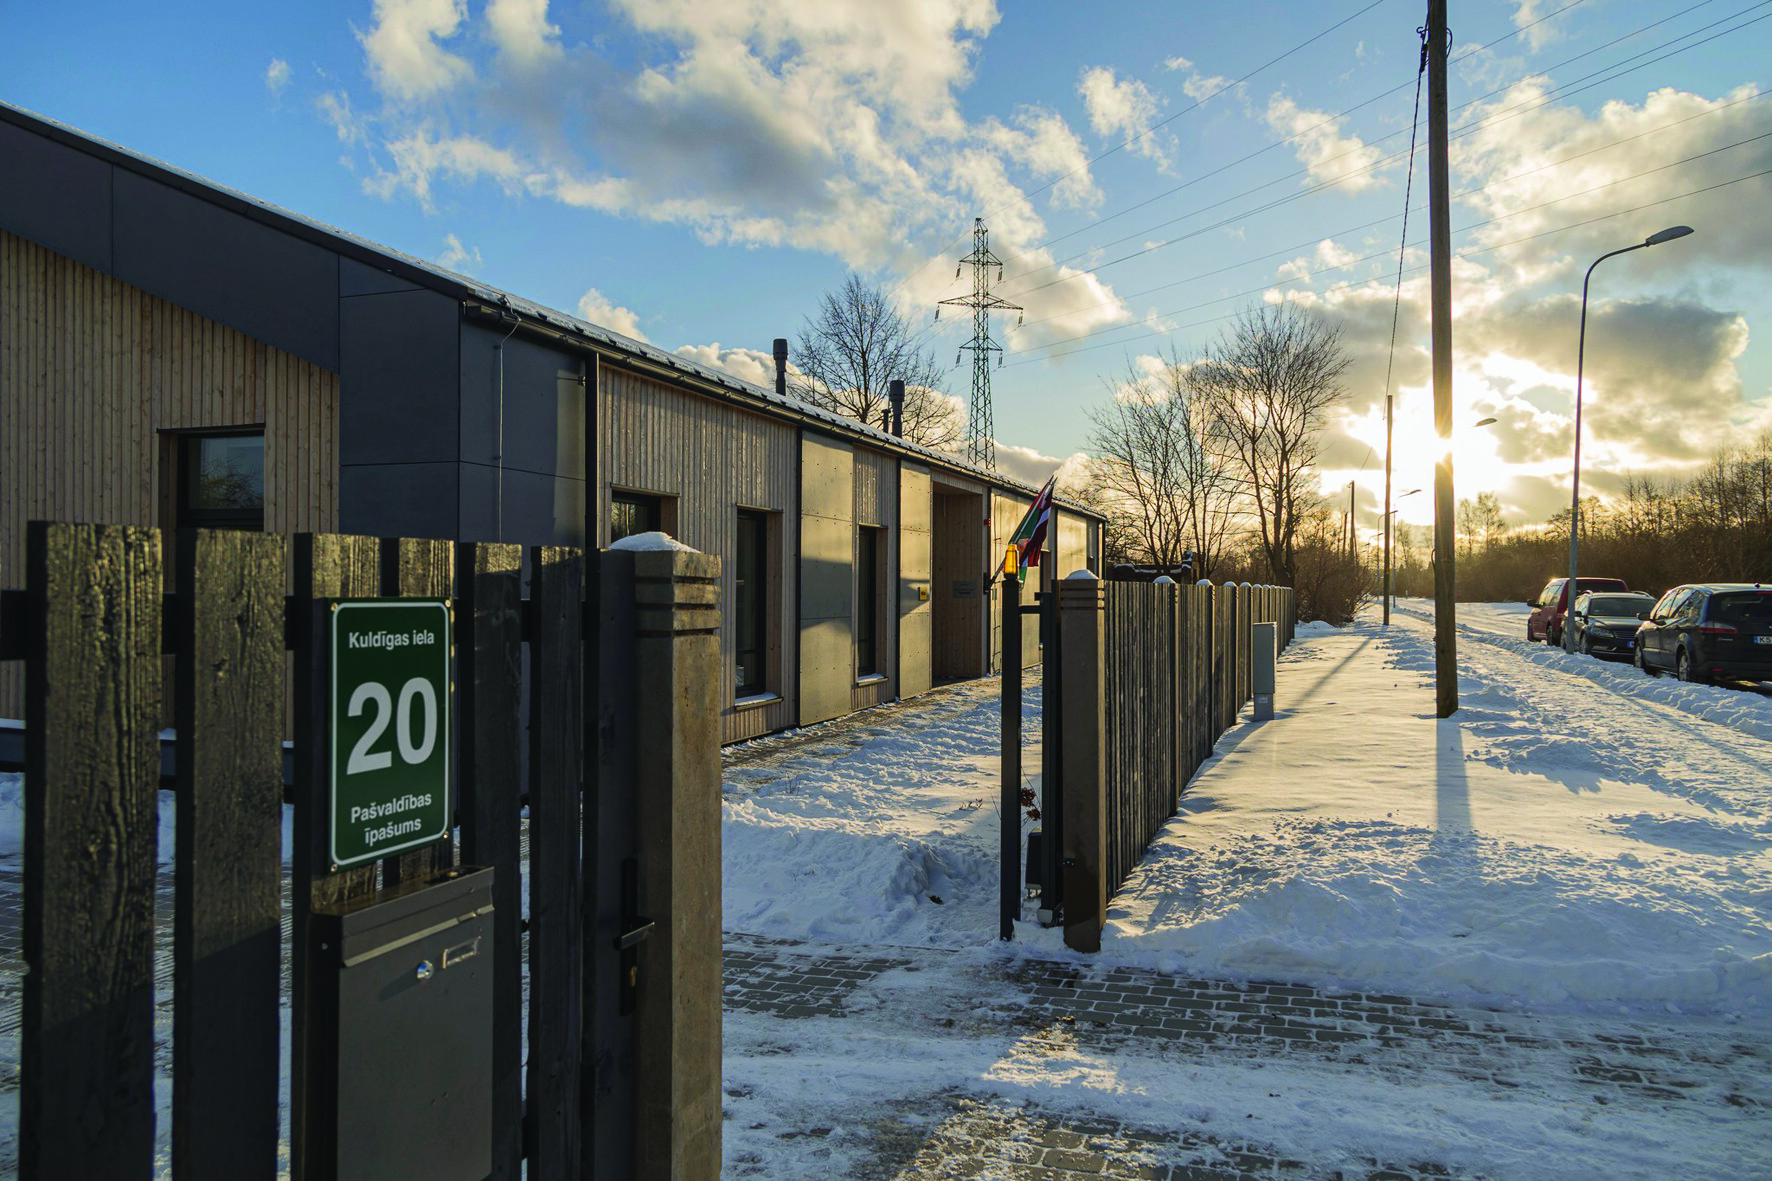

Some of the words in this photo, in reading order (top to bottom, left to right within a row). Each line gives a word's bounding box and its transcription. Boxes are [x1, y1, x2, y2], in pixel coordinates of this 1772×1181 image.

[348, 631, 410, 651] Kuldīgas
[413, 629, 435, 645] iela
[346, 677, 438, 775] 20
[351, 793, 432, 823] Pašvaldības
[364, 818, 422, 847] īpašums
